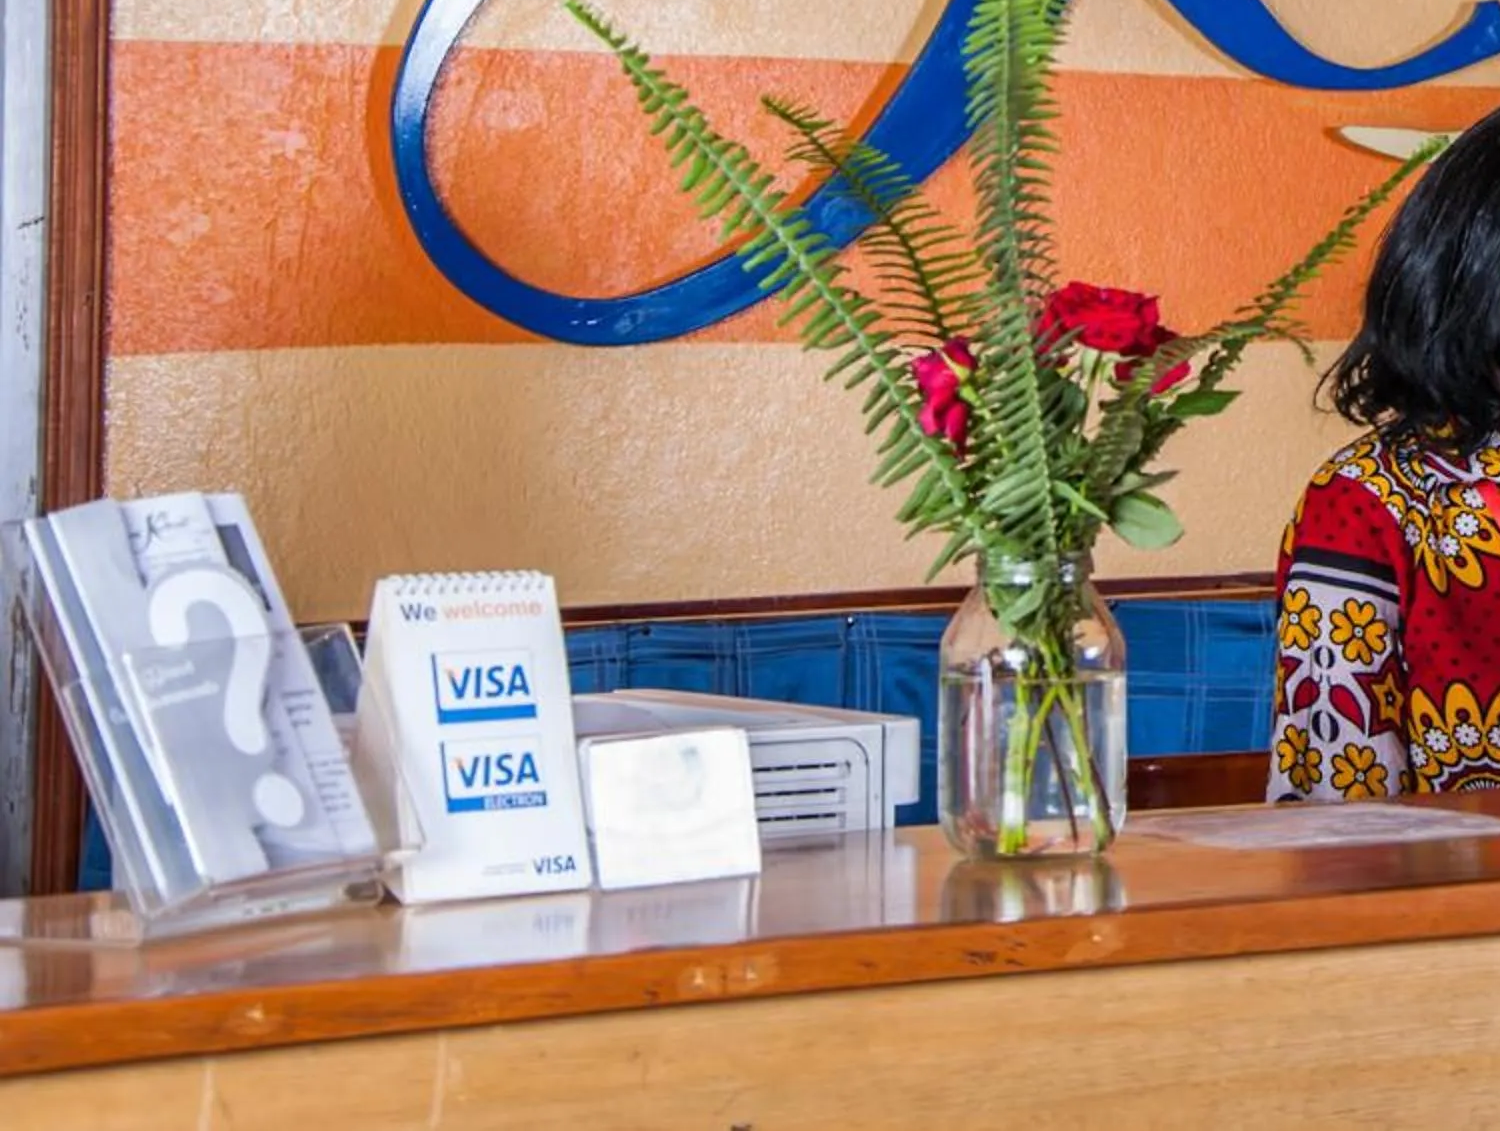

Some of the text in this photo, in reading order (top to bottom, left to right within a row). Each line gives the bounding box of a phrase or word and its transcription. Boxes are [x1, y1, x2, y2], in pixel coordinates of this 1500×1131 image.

[400, 600, 543, 621] We welcome
[446, 664, 531, 699] VISA
[454, 751, 540, 788] VISA
[532, 855, 577, 875] VISA
